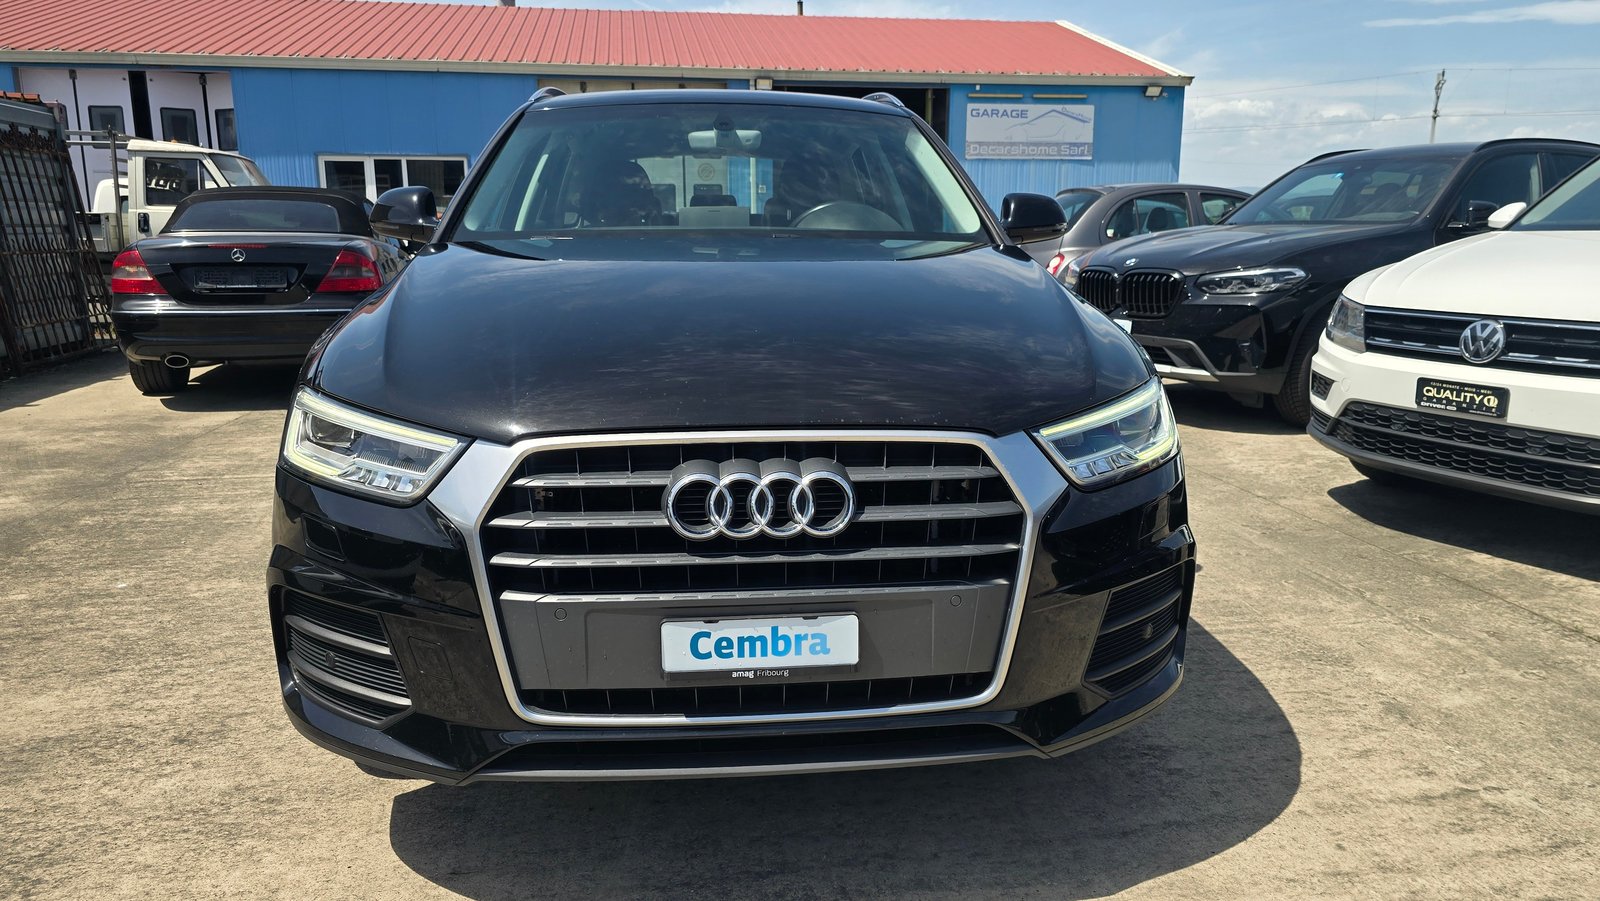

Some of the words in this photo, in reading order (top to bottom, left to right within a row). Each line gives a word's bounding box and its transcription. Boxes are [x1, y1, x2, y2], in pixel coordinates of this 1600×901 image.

[970, 108, 1029, 119] GARAGE
[970, 143, 1058, 155] Decarshome
[1422, 396, 1497, 413] GARANTIE
[689, 626, 831, 660] Cembra
[731, 670, 755, 679] amag
[756, 669, 790, 678] Fribourg
